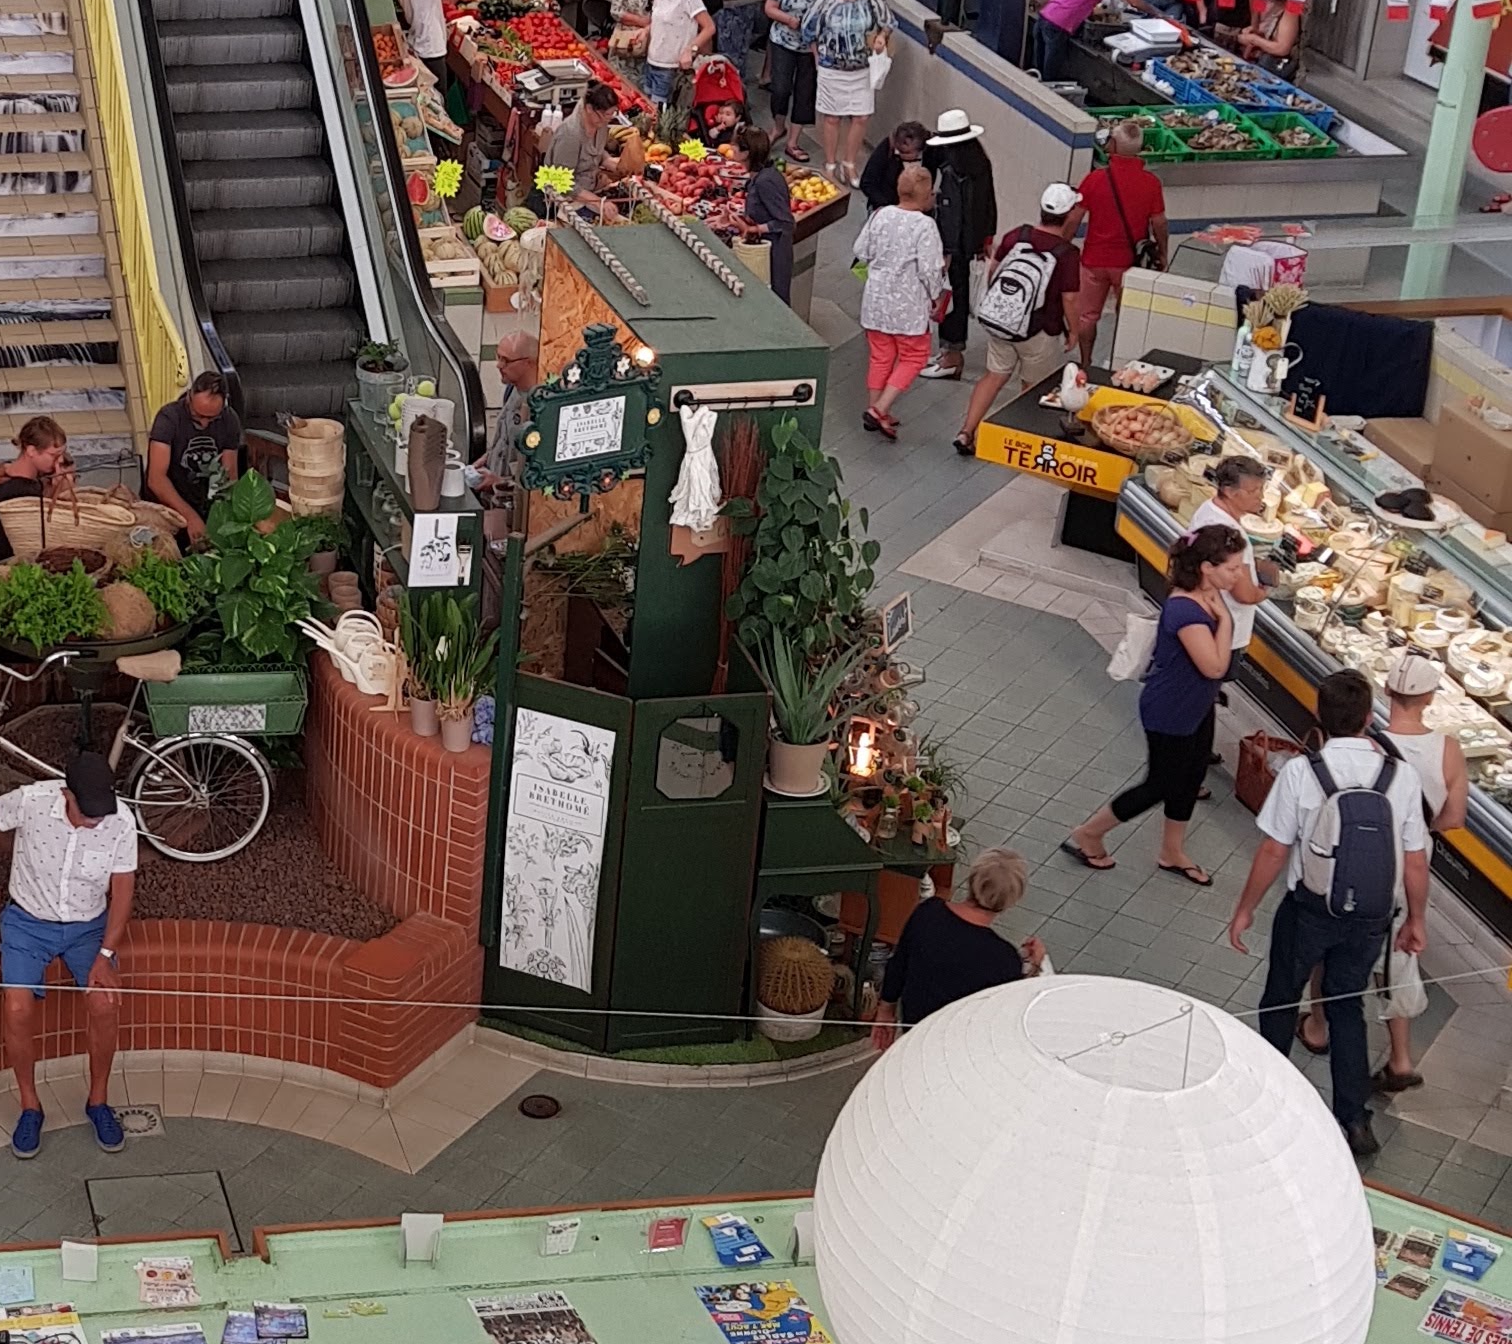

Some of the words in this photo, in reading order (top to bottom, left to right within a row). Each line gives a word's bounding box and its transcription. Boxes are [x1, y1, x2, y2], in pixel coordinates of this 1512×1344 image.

[1004, 437, 1013, 445] LE
[1016, 439, 1033, 451] BON
[1004, 446, 1098, 486] TERROIR
[533, 783, 588, 805] ISABELLE
[1424, 1313, 1467, 1339] TENNIS
[1467, 1326, 1484, 1344] DE
